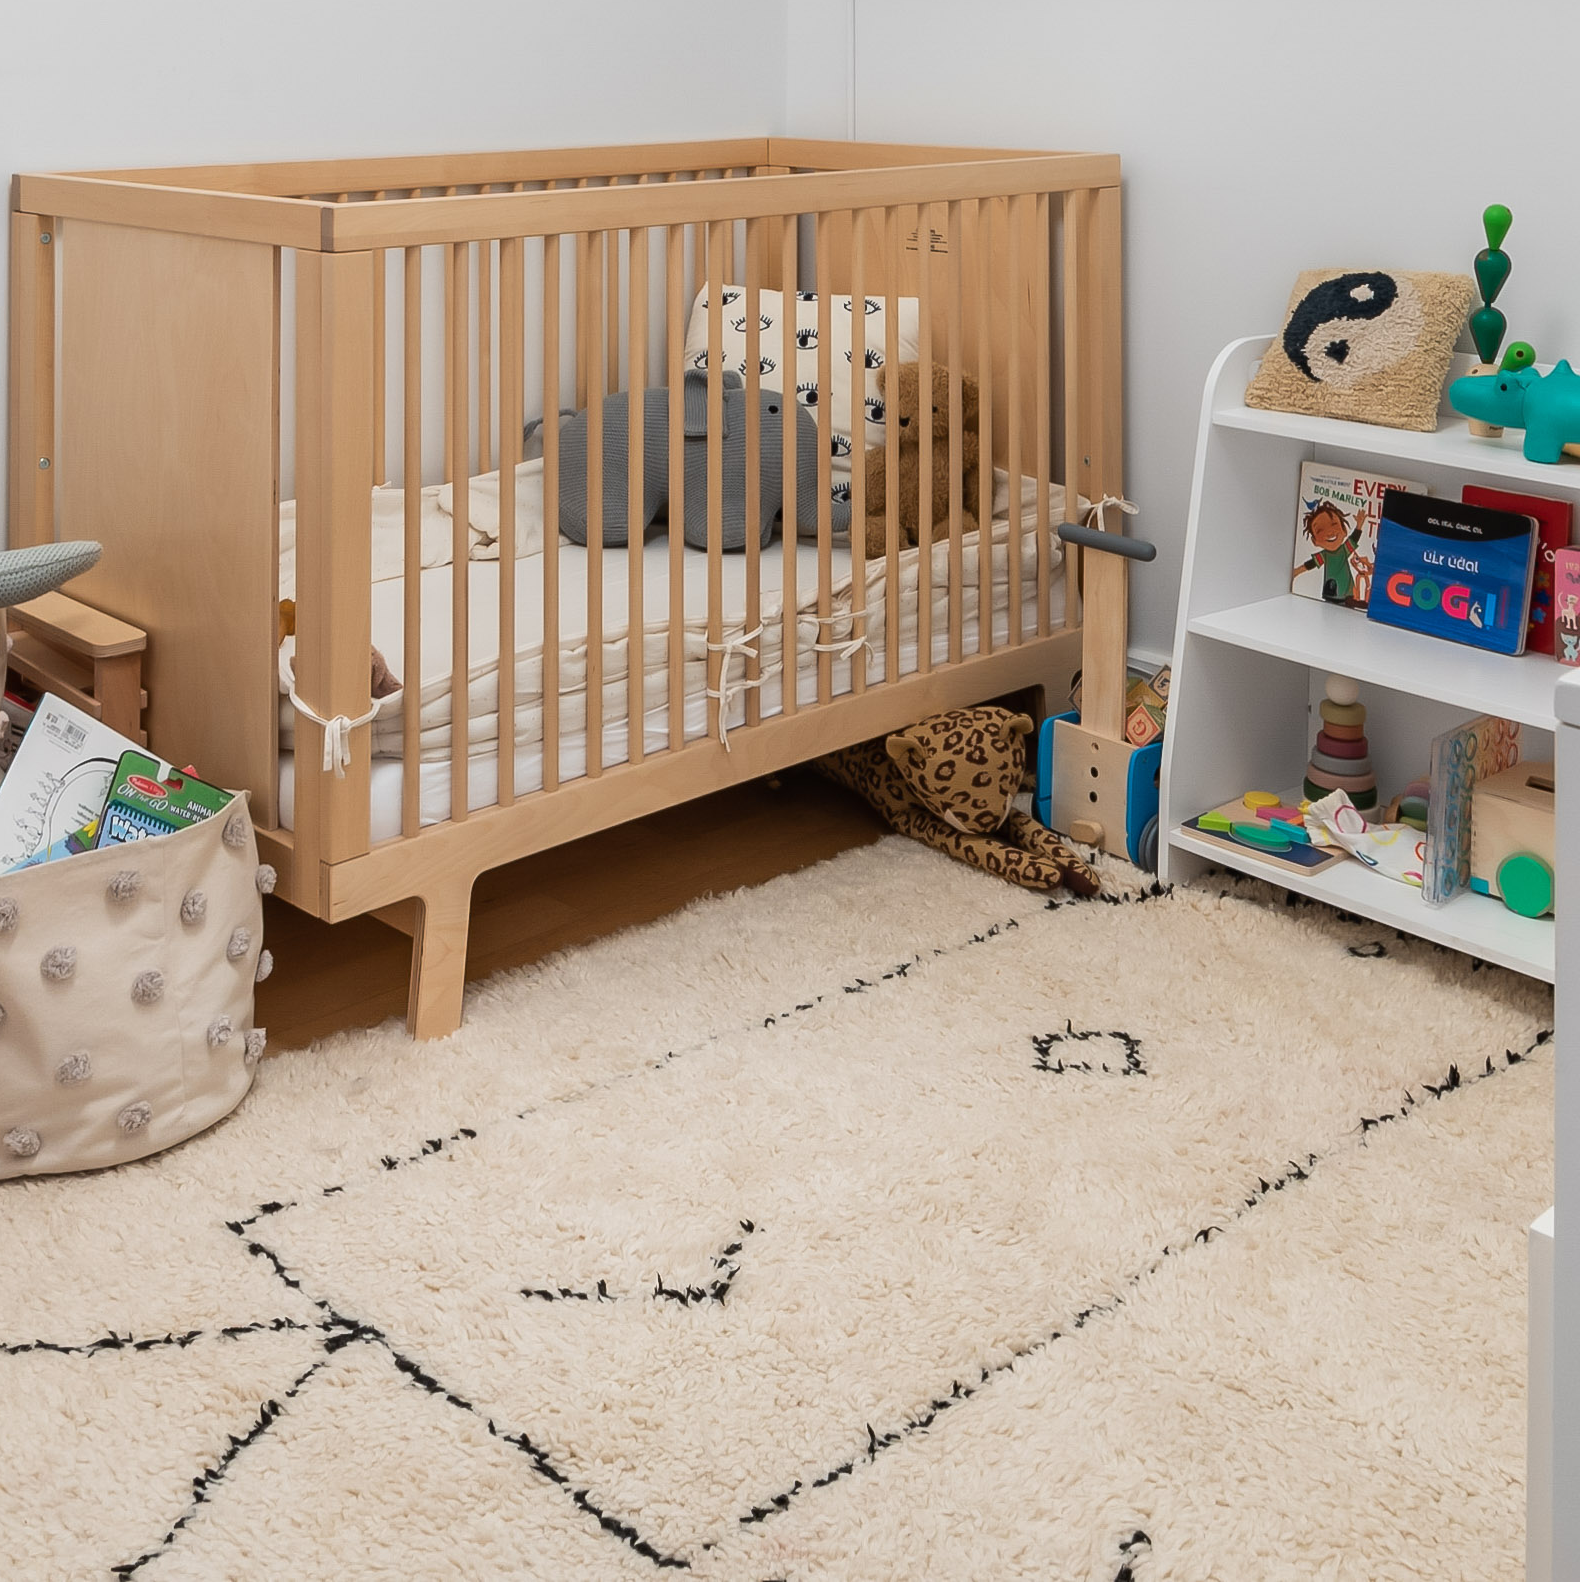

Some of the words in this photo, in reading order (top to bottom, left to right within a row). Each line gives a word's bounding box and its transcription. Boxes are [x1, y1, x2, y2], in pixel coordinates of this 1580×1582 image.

[1314, 485, 1329, 497] BOB
[1332, 491, 1368, 508] MARLEY
[117, 783, 137, 798] ON
[148, 798, 168, 811] GO
